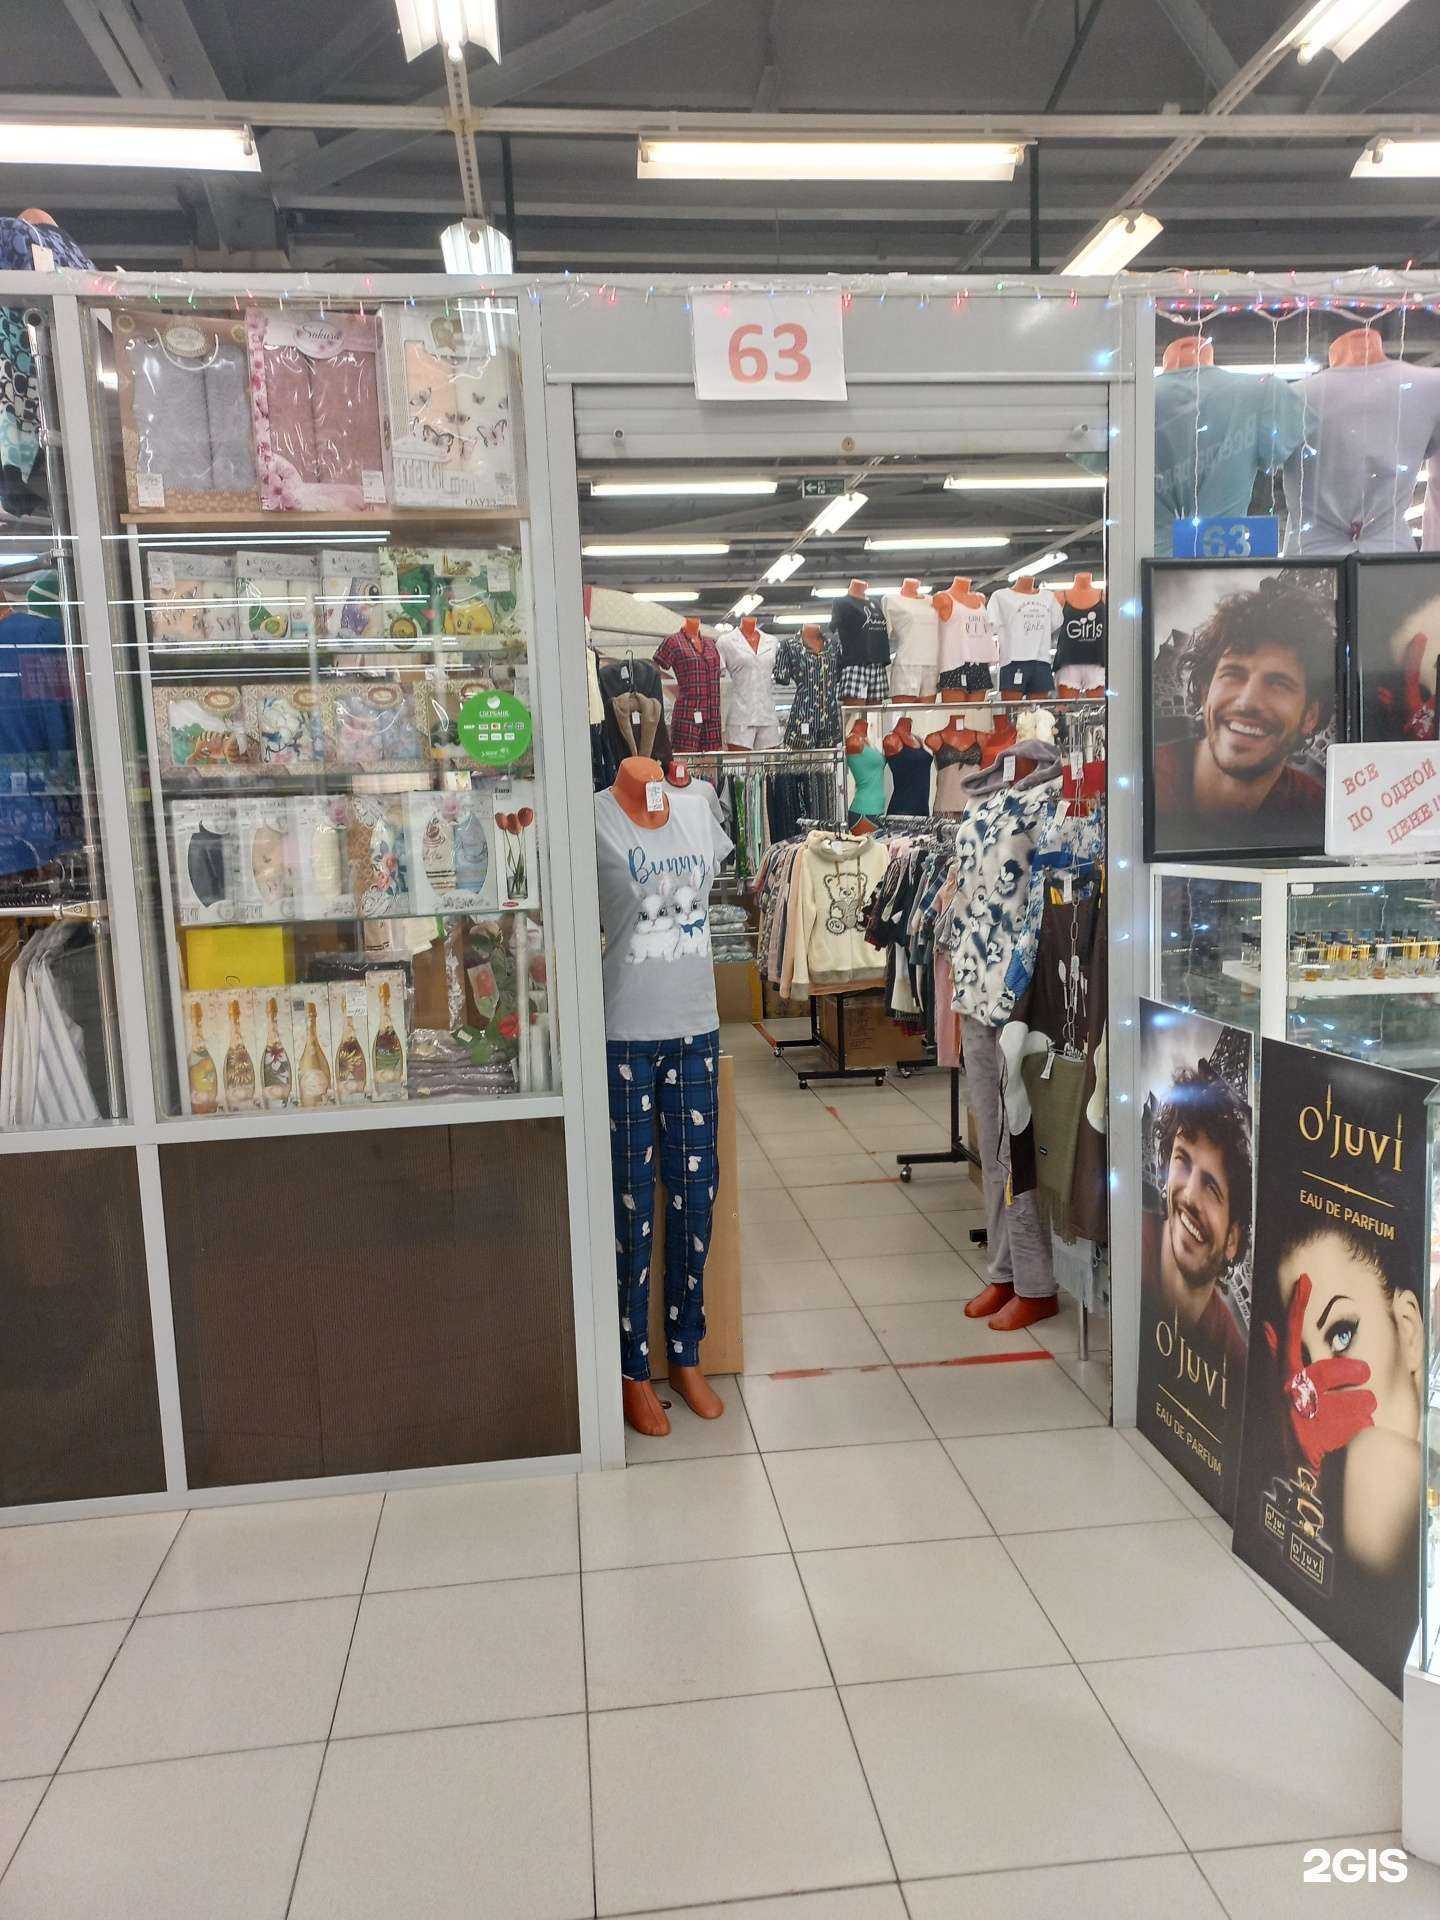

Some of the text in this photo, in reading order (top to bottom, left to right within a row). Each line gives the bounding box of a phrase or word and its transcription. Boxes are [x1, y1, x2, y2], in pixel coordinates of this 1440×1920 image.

[729, 323, 811, 384] 63
[1203, 524, 1251, 557] 63
[1066, 616, 1103, 640] Girls
[1342, 762, 1380, 796] ВСЕ
[1347, 805, 1384, 833] ПО
[628, 846, 706, 889] Bunny
[1300, 1189, 1395, 1240] EAU DE PARFUM
[1156, 1402, 1222, 1476] EAU DE PARFUM
